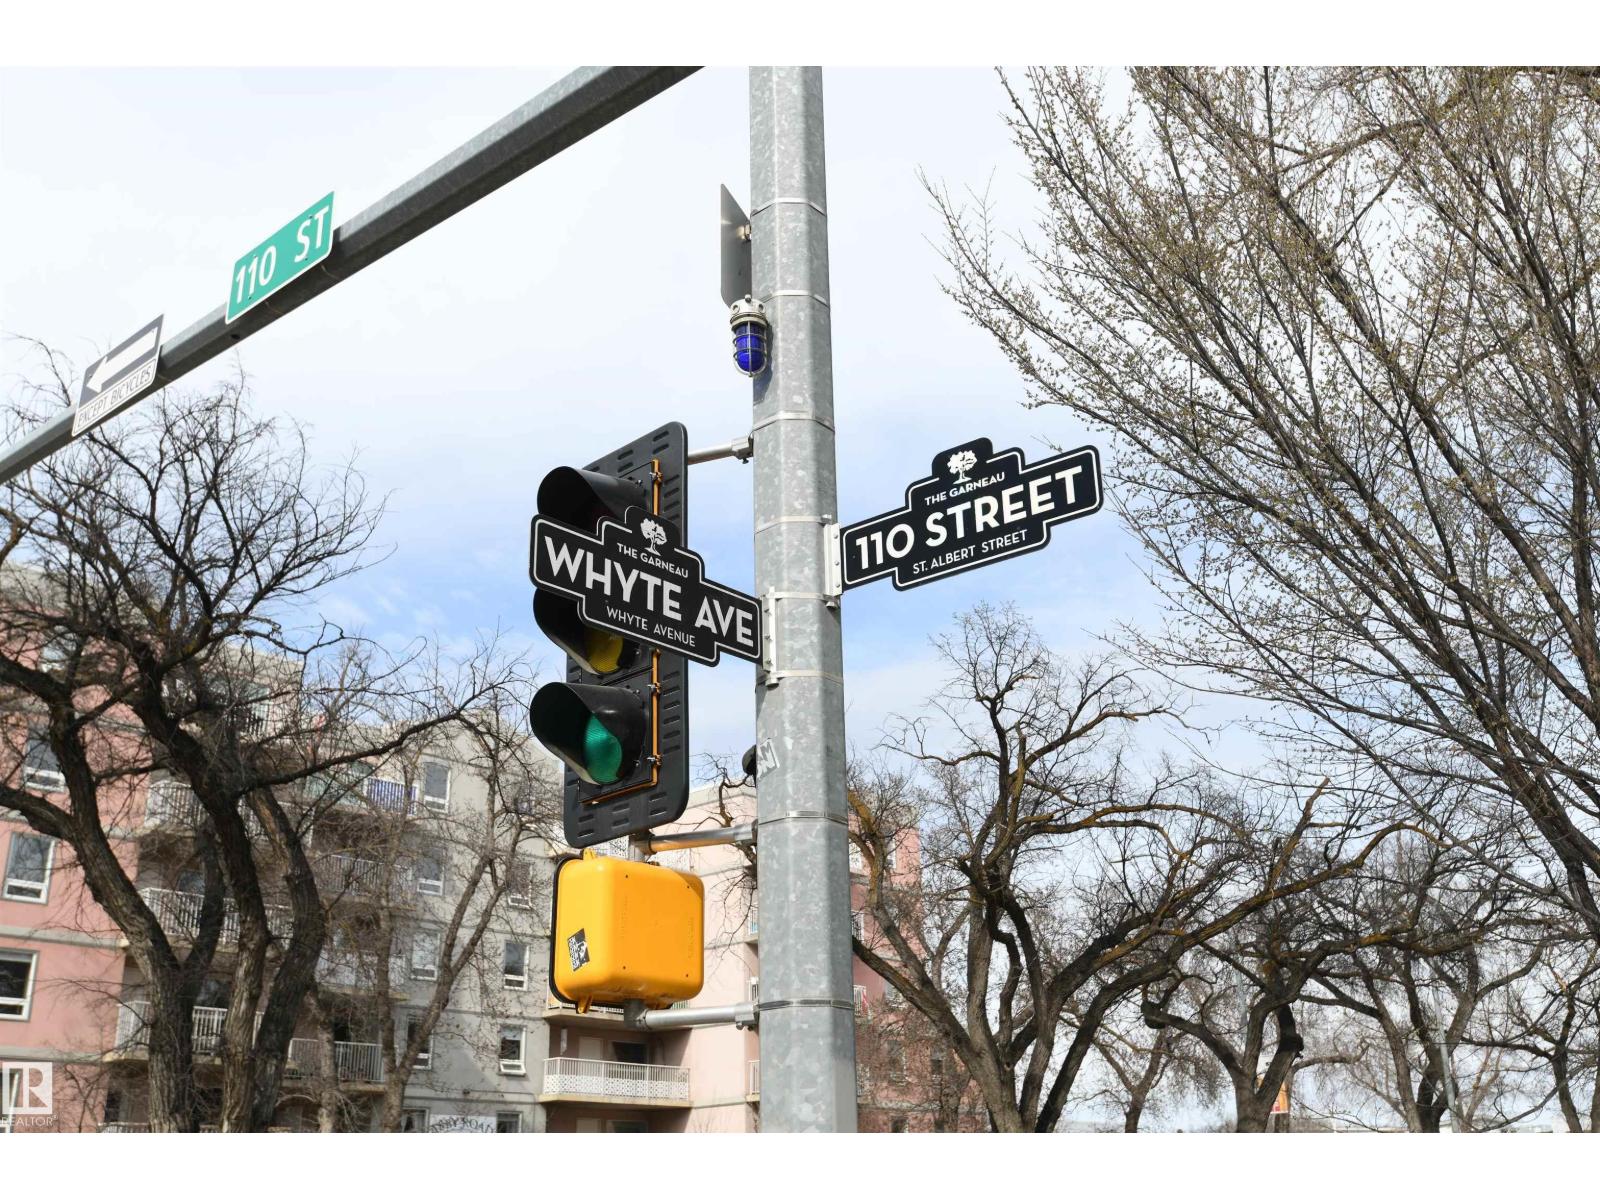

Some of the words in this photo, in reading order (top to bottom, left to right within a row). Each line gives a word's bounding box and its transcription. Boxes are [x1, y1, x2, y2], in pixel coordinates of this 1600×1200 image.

[236, 245, 277, 304] 110
[294, 205, 329, 263] ST
[77, 395, 108, 428] EXCEPT
[111, 364, 152, 405] BICYCLES
[924, 493, 947, 507] THE
[949, 471, 1005, 498] GARNEAU
[855, 523, 915, 570] 110
[925, 465, 1083, 547] STREET
[616, 542, 638, 560] THE
[640, 551, 689, 579] GARNEAU
[912, 561, 928, 575] ST.
[930, 545, 976, 569] ALBERT
[981, 529, 1029, 553] STREET
[544, 535, 682, 621] WHYTE
[694, 595, 754, 647] AVE
[606, 605, 649, 631] WHYTE
[653, 624, 696, 647] AVENUE
